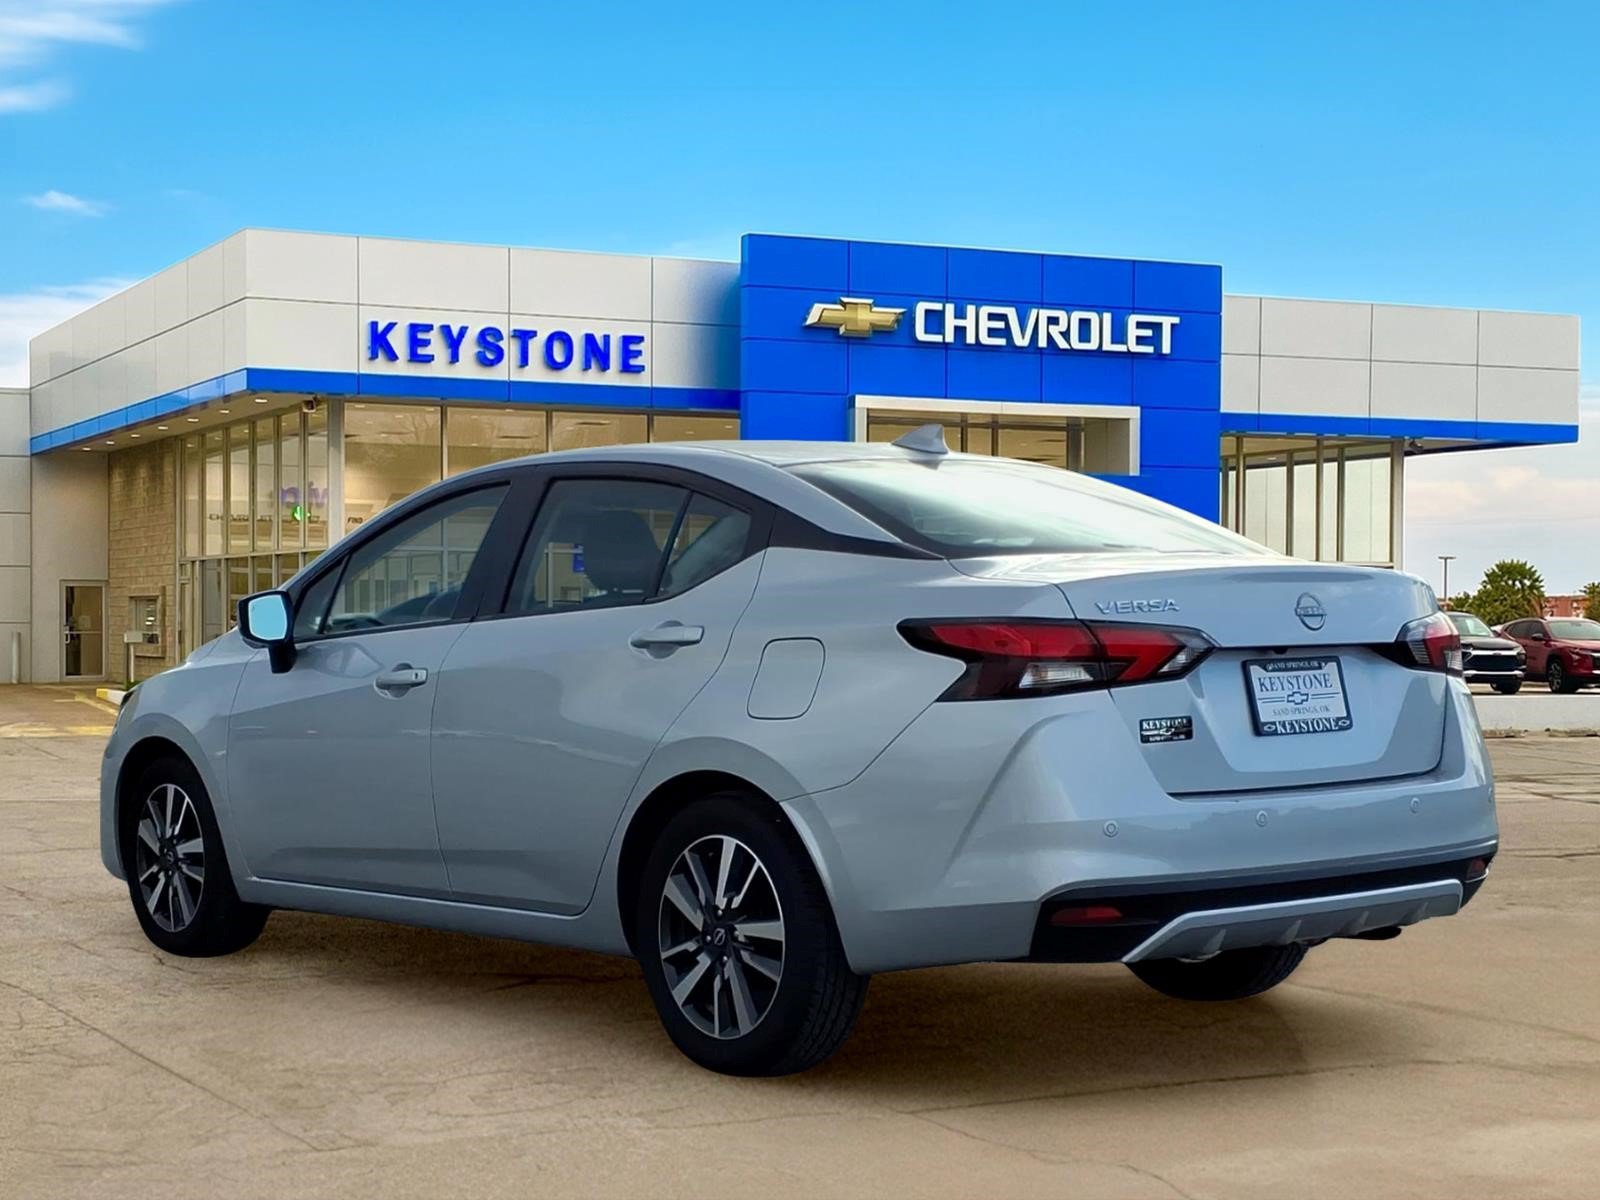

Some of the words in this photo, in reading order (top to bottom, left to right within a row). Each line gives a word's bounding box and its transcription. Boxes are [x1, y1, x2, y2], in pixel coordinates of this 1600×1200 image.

[915, 301, 1180, 355] CHEVROLET
[368, 321, 646, 374] KEYSTONE
[1094, 598, 1180, 614] VERSA
[1258, 673, 1333, 692] KEYSTONE
[1276, 718, 1339, 734] KEYSTONE
